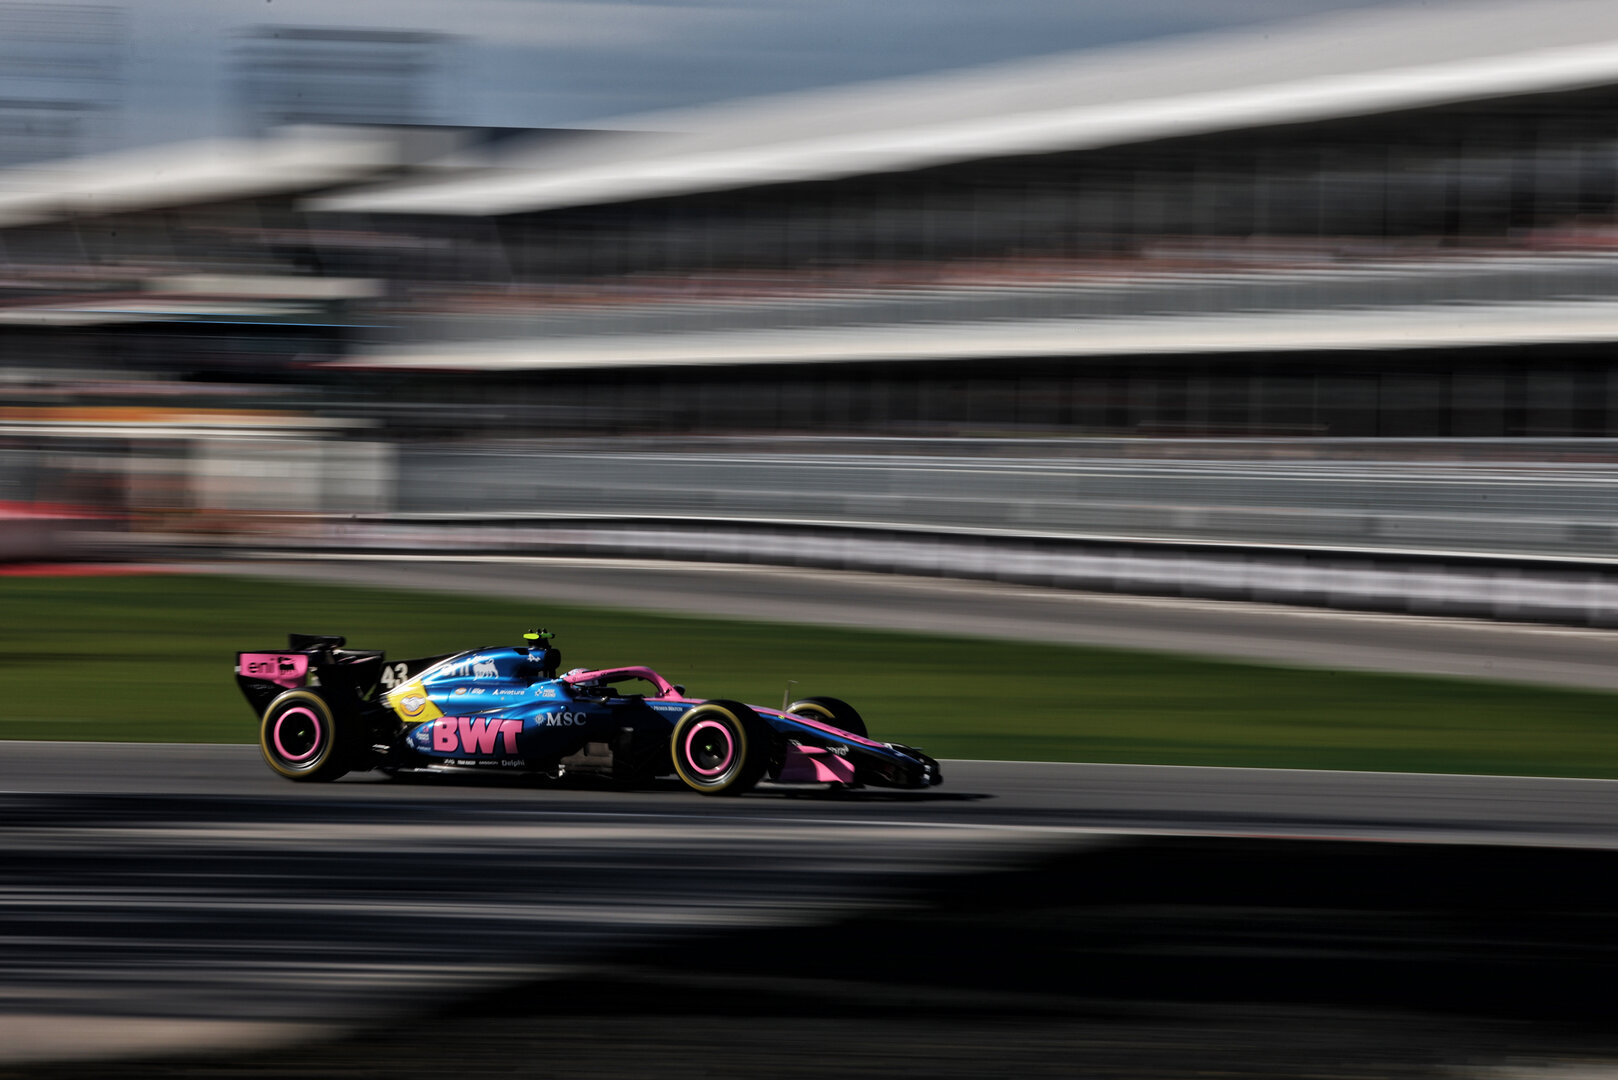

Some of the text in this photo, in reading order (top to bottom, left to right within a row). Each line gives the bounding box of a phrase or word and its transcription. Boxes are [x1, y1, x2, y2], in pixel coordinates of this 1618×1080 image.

[248, 658, 275, 674] eni
[380, 662, 409, 689] 43
[546, 711, 587, 727] MSC
[432, 716, 524, 755] BWT
[501, 759, 525, 768] Delphi
